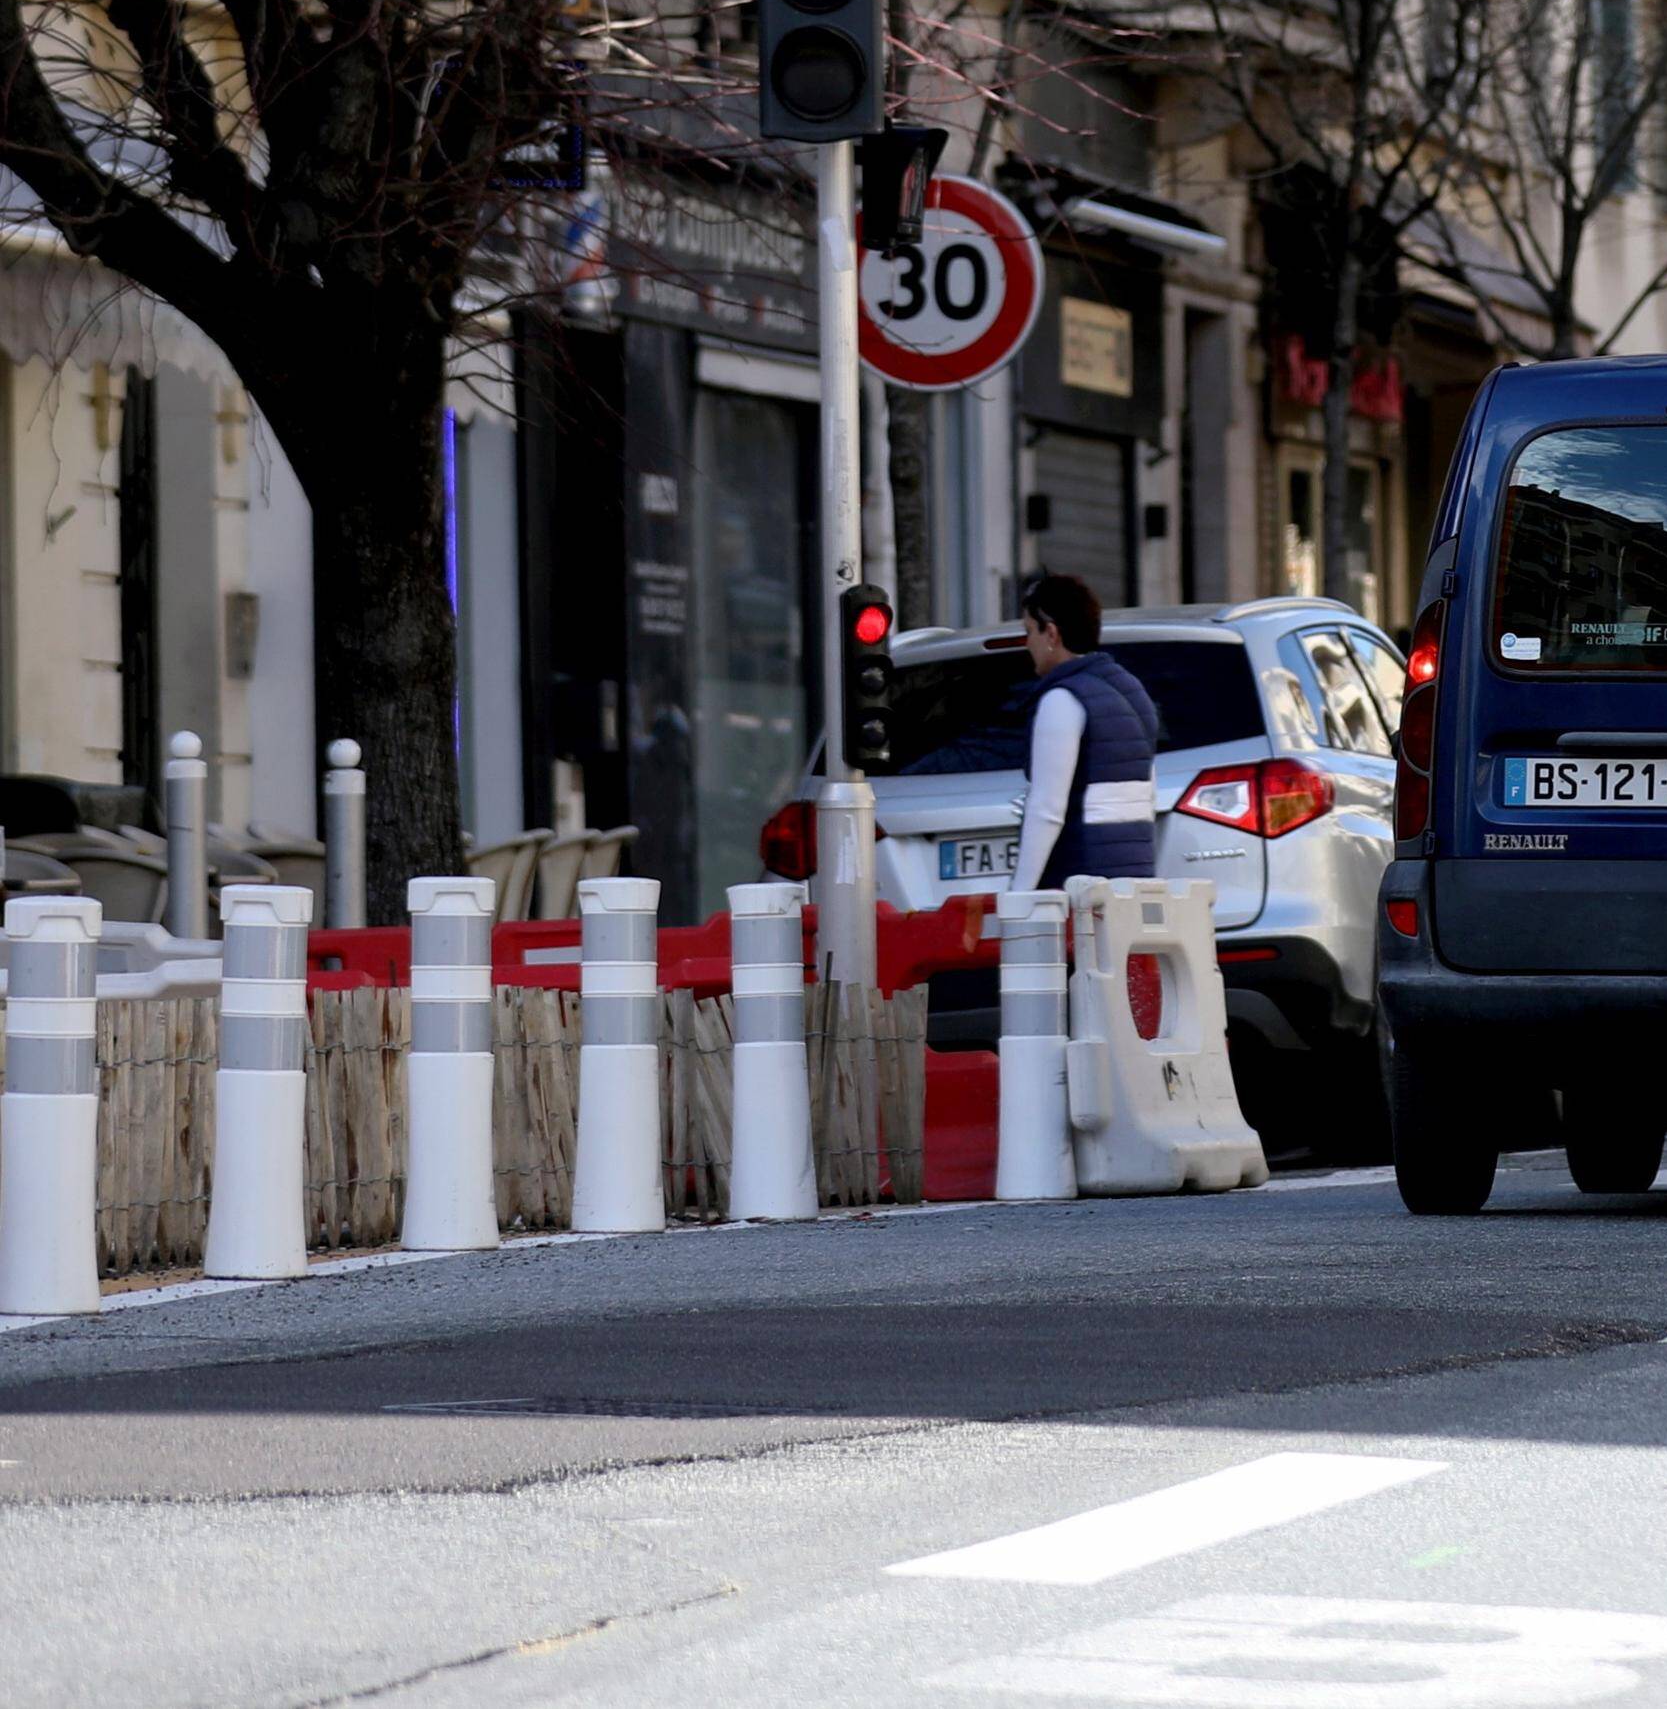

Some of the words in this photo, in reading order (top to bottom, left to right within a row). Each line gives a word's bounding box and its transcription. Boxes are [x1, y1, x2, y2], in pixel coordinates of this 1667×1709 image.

[879, 243, 987, 320] 30
[1571, 623, 1626, 634] RENAULT
[1511, 786, 1519, 798] F
[1484, 834, 1568, 850] RENAULT
